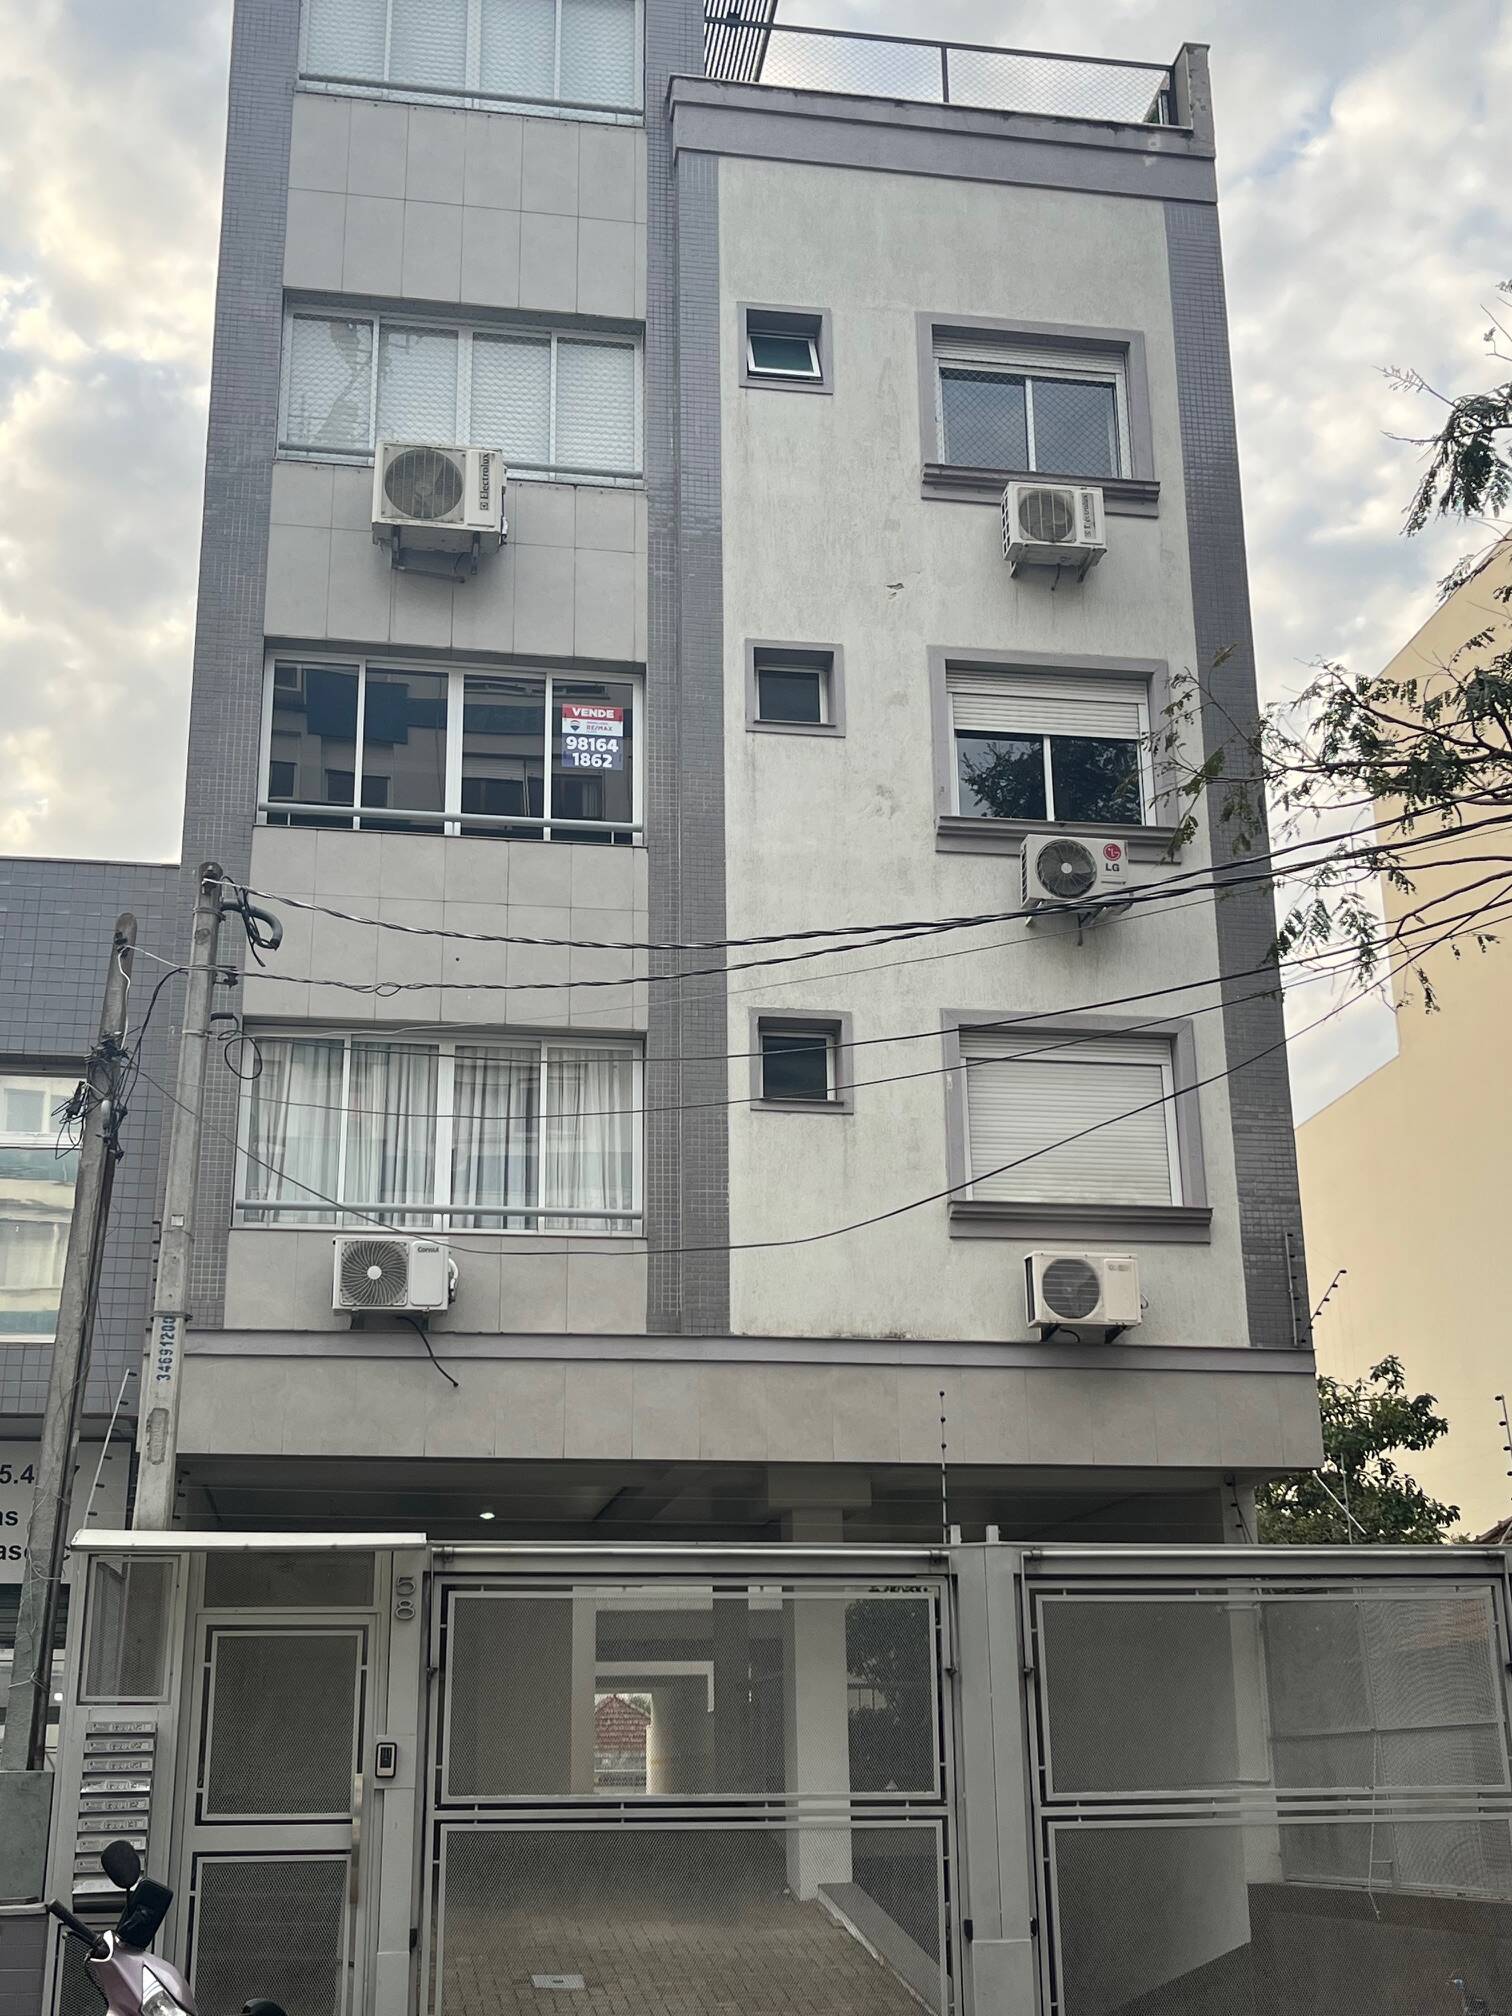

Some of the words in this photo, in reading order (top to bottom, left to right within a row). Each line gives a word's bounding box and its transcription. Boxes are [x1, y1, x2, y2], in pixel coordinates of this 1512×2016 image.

[479, 452, 490, 500] Electrolux
[572, 707, 615, 719] VENDE
[565, 735, 619, 753] 98164
[572, 752, 613, 768] 1862
[1105, 863, 1120, 872] LG
